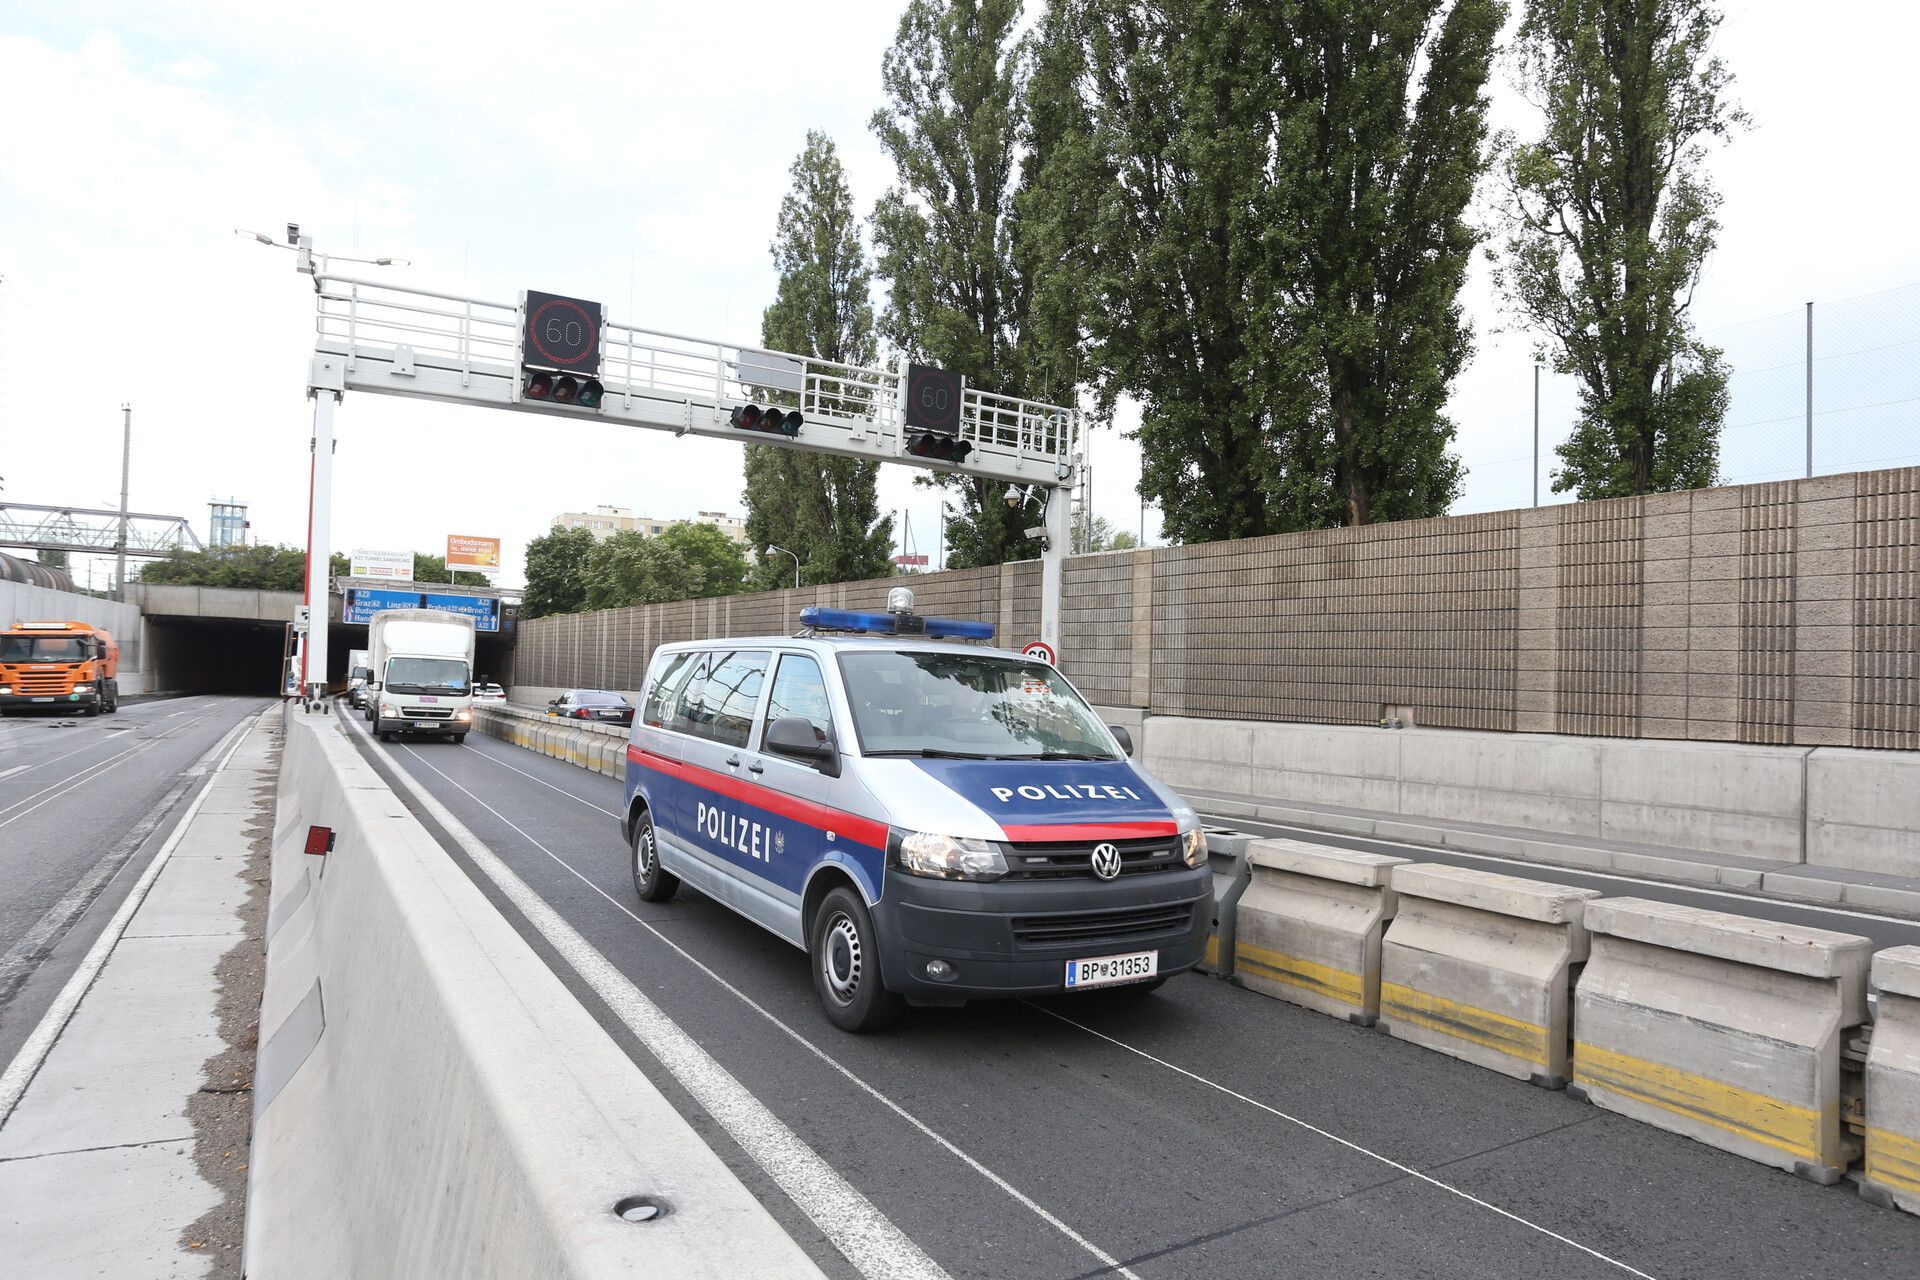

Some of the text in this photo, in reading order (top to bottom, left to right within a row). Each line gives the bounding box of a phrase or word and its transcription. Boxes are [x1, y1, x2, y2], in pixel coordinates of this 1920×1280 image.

[545, 317, 582, 347] 60
[920, 387, 947, 410] 60
[450, 537, 495, 547] Ombudsmann
[355, 599, 371, 607] Graz
[386, 601, 402, 609] Linz
[426, 604, 447, 612] Praha
[990, 783, 1141, 803] POLIZEI
[697, 801, 770, 863] POLIZEI
[1082, 962, 1099, 981] BP
[1110, 956, 1150, 977] 31353
